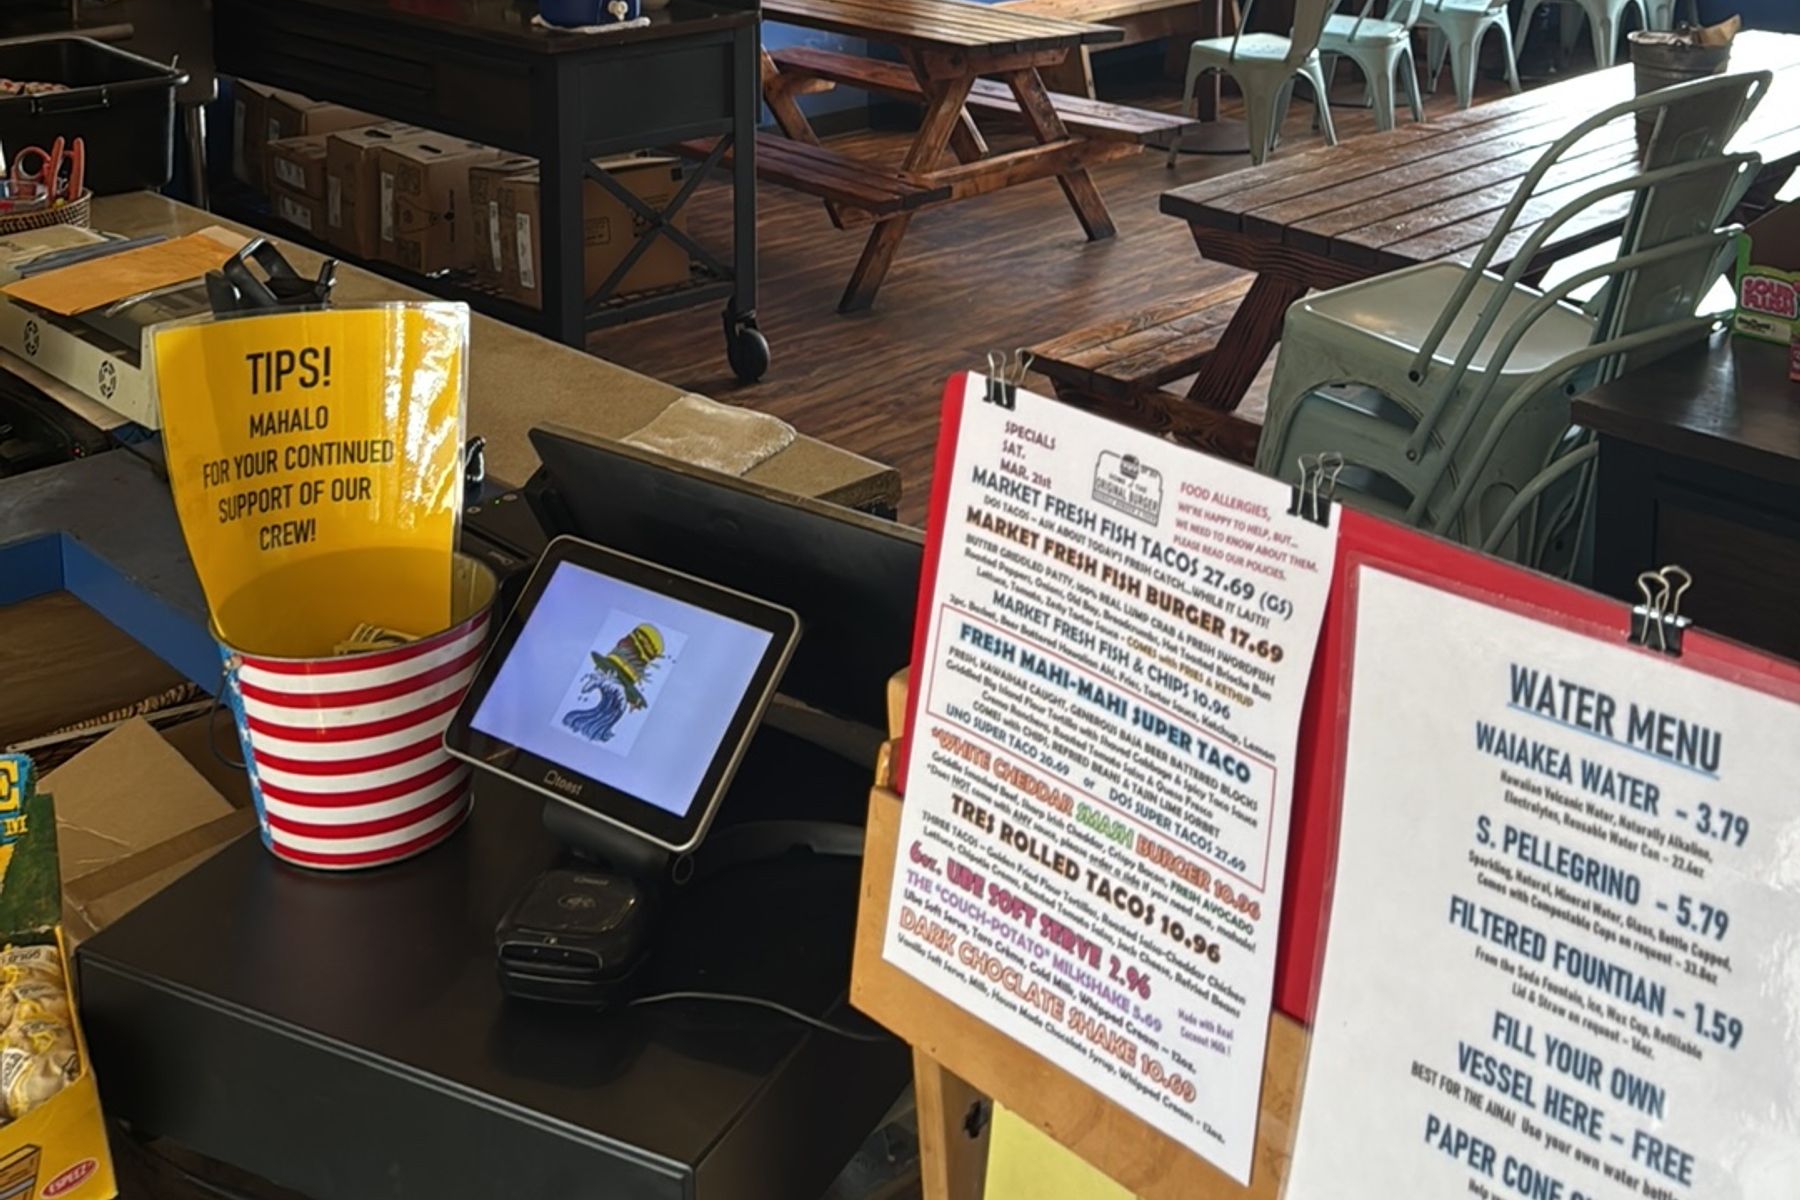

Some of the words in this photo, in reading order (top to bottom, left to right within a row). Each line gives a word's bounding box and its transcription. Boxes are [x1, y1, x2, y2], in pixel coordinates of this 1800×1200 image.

[245, 345, 332, 395] TIPS!
[249, 404, 329, 439] MAHALO
[202, 459, 230, 490] FOR
[233, 448, 278, 478] YOUR
[284, 438, 394, 472] CONTINUED
[999, 457, 1029, 480] MAR.
[1031, 471, 1052, 489] 21st
[1002, 439, 1026, 459] SAT.
[1004, 420, 1056, 450] SPECIALS
[218, 483, 292, 524] SUPPORT
[299, 479, 324, 506] OF
[331, 476, 372, 502] OUR
[259, 517, 316, 551] CREW!
[971, 465, 1041, 507] MARKET
[1044, 495, 1097, 532] FRESH
[1099, 519, 1137, 550] FISH
[1141, 536, 1199, 577] TACOS
[1202, 565, 1255, 600] 27.69
[1259, 591, 1293, 621] (GS)
[1173, 534, 1200, 552] PLEASE
[1201, 544, 1224, 559] READ
[1225, 552, 1245, 566] OUR
[1245, 559, 1286, 581] POLICIES.
[1180, 481, 1210, 501] FOOD
[1211, 491, 1271, 522] ALLERGIES,
[1203, 511, 1232, 526] HAPPY
[1233, 519, 1246, 531] TO
[1246, 524, 1271, 541] HELP,
[966, 506, 1040, 550] MARKET
[1042, 538, 1098, 577] FRESH
[1100, 564, 1141, 598] FISH
[1145, 584, 1226, 638] BURGER
[1230, 626, 1284, 663] 17.69
[960, 622, 1016, 663] FRESH
[1019, 650, 1128, 719] MAHI-MAHI
[1132, 706, 1192, 753] SUPER
[1196, 739, 1251, 784] TACO
[992, 589, 1051, 627] MARKET
[1052, 617, 1096, 651] FRESH
[1098, 639, 1130, 668] FISH
[1132, 657, 1144, 675] &
[1147, 664, 1189, 698] CHIPS
[1192, 688, 1231, 720] 10.96
[1510, 663, 1616, 738] WATER
[1626, 703, 1722, 774] MENU
[946, 703, 971, 724] UNO
[973, 716, 1007, 742] SUPER
[1009, 733, 1038, 759] TACO
[1083, 777, 1095, 789] or
[1108, 787, 1132, 810] DOS
[1134, 801, 1172, 831] SUPER
[1174, 822, 1212, 854] TACOS
[992, 758, 1074, 817] CHEDDAR
[1075, 803, 1134, 849] SMASH
[1135, 834, 1211, 893] BURGER
[1476, 720, 1573, 784] WAIAKEA
[1581, 758, 1660, 816] WATER
[1695, 802, 1749, 847] 3.79
[946, 858, 986, 899] UBE
[988, 882, 1038, 929] SOFT
[1039, 913, 1103, 970] SERVE
[1108, 954, 1151, 1000] 2.96
[951, 793, 995, 834] TRES
[999, 821, 1080, 882] ROLLED
[1086, 869, 1155, 926] TACOS
[1160, 914, 1220, 964] 10.96
[1476, 814, 1496, 848] S.
[1502, 824, 1640, 906] PELLEGRINO
[1676, 894, 1729, 941] 5.79
[899, 905, 957, 956] DARK
[958, 941, 1065, 1022] CHOCLATE
[1067, 1007, 1138, 1068] SHAKE
[907, 868, 933, 894] THE
[1051, 953, 1130, 1014] MILKSHAKE
[1449, 895, 1547, 962] FILTERED
[1552, 940, 1666, 1016] FOUNTIAN
[1694, 1002, 1743, 1050] 1.59
[1458, 1041, 1536, 1109] VESSEL
[1543, 1085, 1604, 1142] HERE
[1631, 1129, 1694, 1187] FREE
[1492, 1010, 1536, 1058] FILL
[1545, 1034, 1603, 1090] YOUR
[1610, 1067, 1665, 1119] OWN
[1424, 1113, 1498, 1179] PAPER
[1502, 1155, 1564, 1200] CONE
